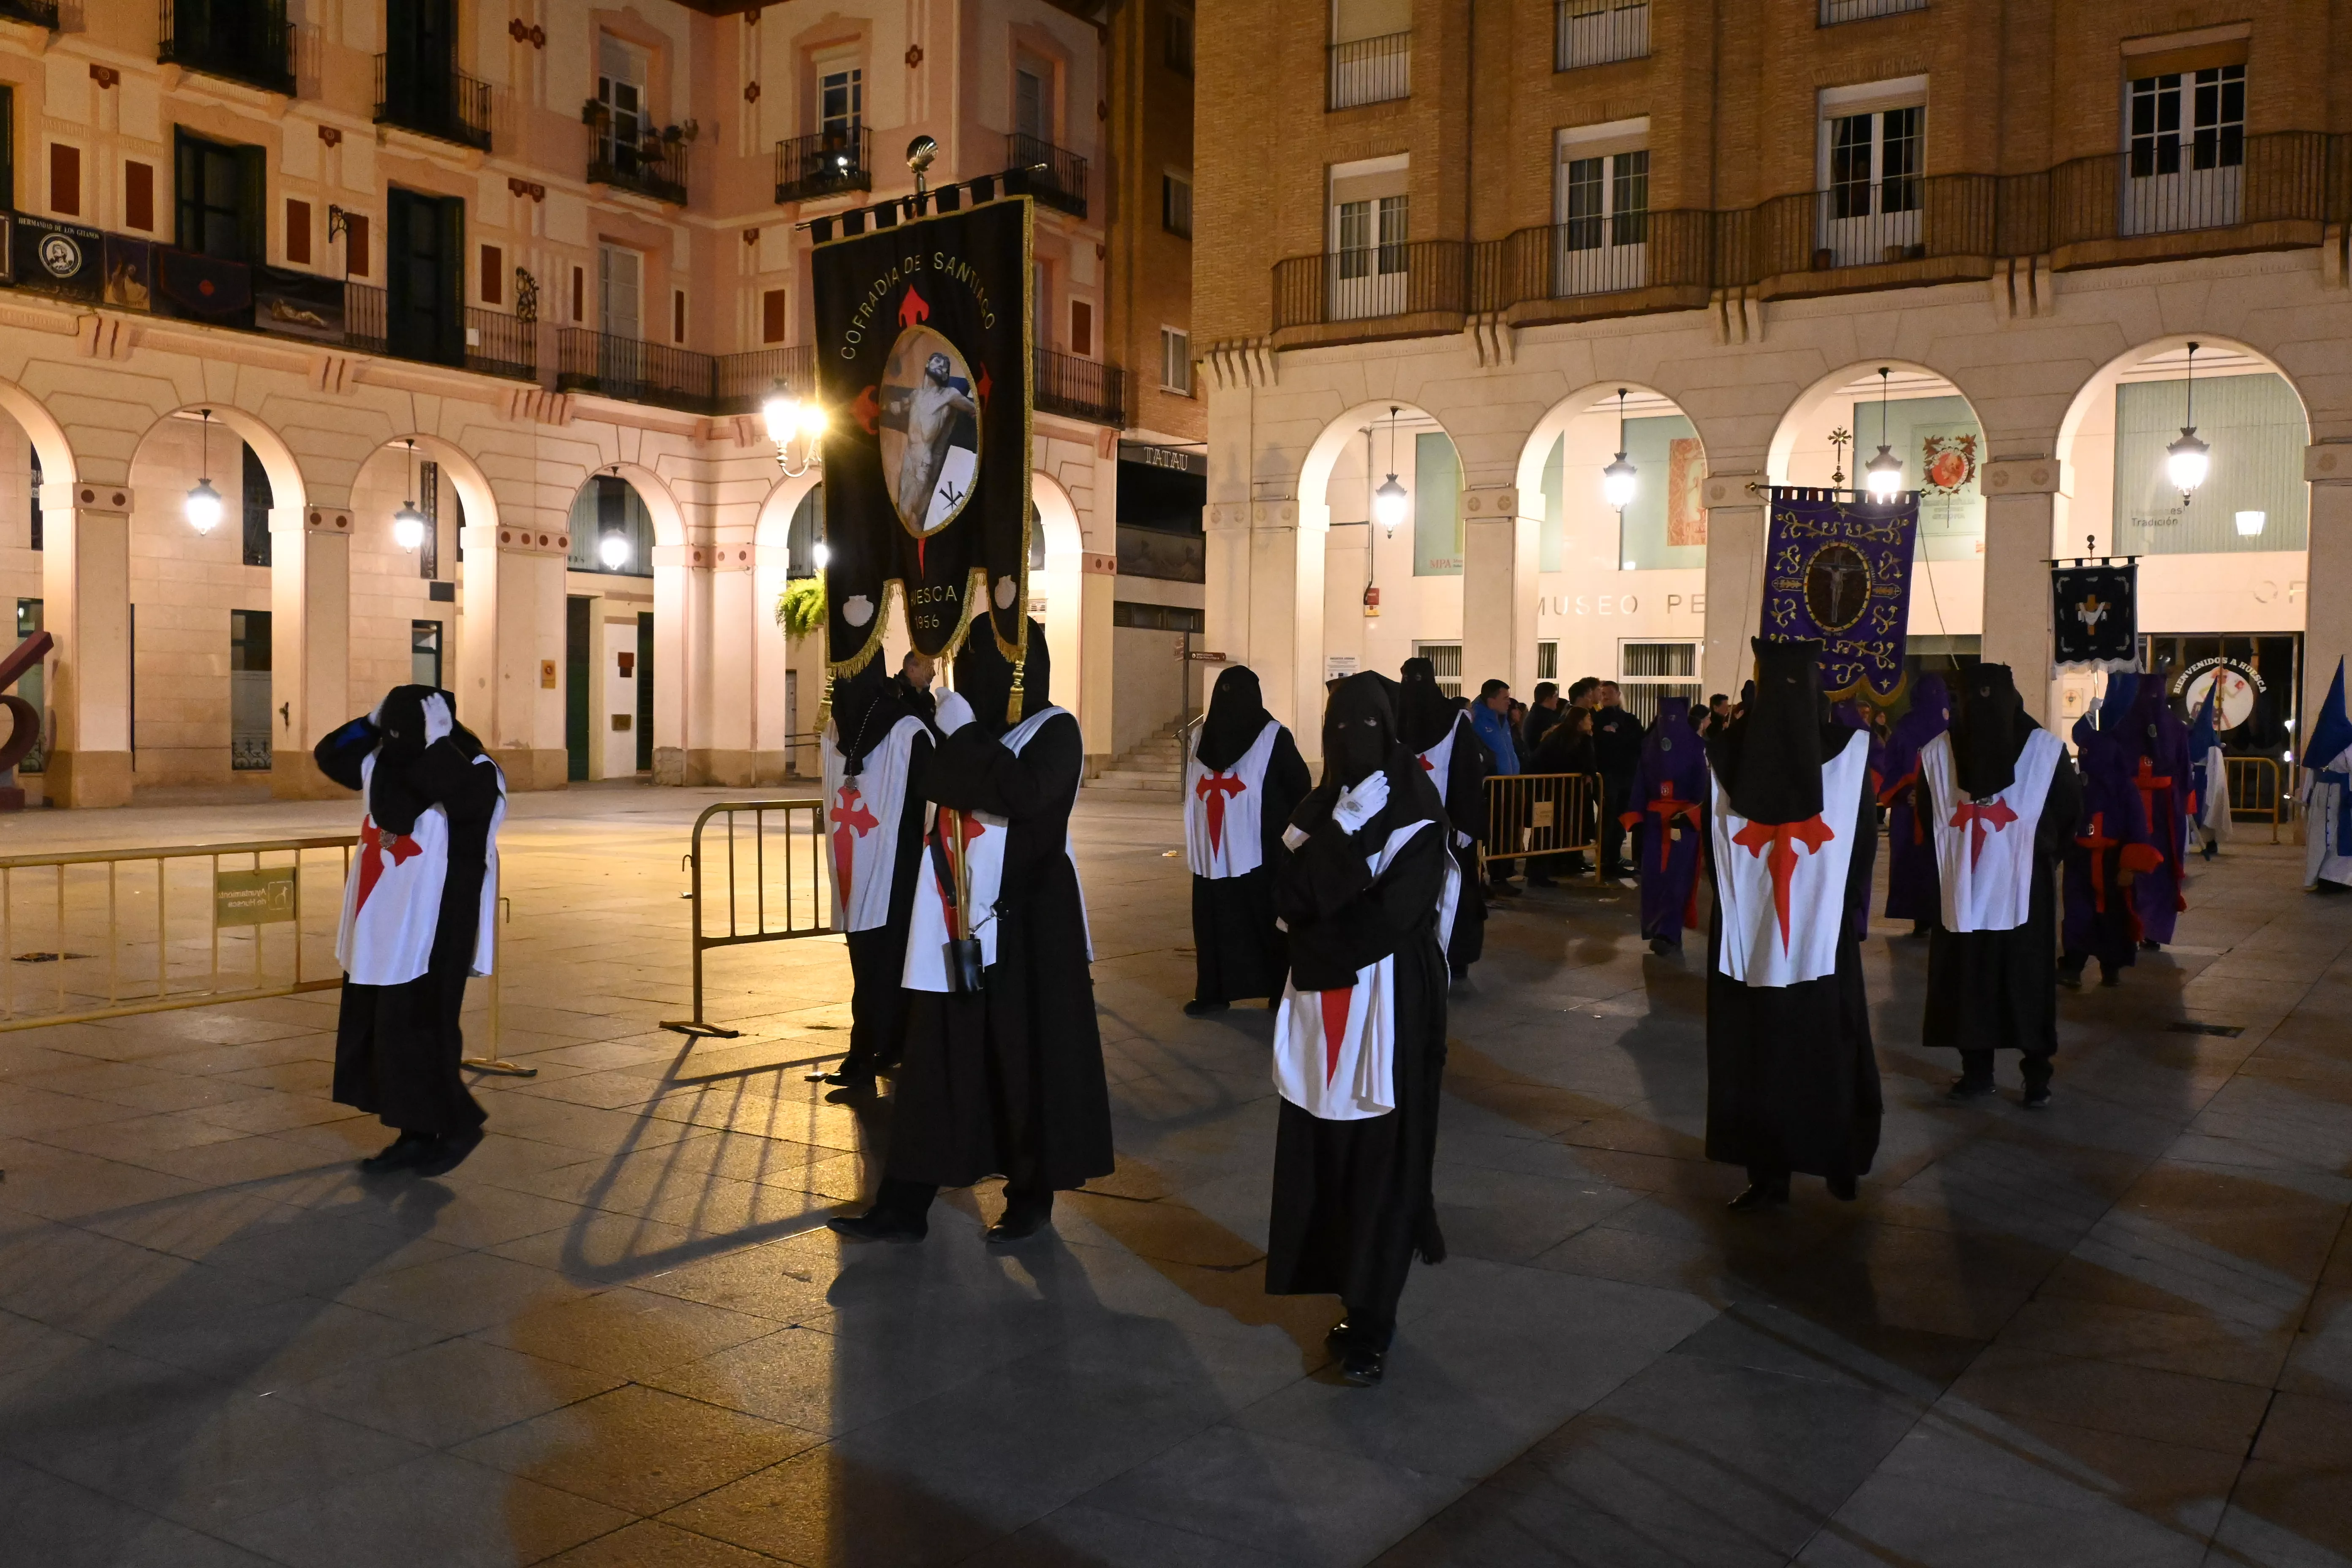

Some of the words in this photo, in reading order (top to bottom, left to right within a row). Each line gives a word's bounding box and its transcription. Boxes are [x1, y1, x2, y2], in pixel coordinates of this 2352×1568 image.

[19, 217, 53, 230] HERMANDAD
[76, 229, 100, 240] GITANOS
[841, 267, 900, 359] COFRADIA
[904, 254, 921, 274] DE
[933, 252, 995, 329] SANTIAGO
[1144, 446, 1188, 471] TATAU
[2131, 516, 2178, 527] Tradición
[1429, 558, 1452, 569] MPA
[910, 585, 958, 607] HUESCA
[915, 614, 940, 629] 1956
[2173, 657, 2228, 694] BIENVENIDOS
[2229, 658, 2237, 666] A
[2238, 661, 2268, 694] HUESCA
